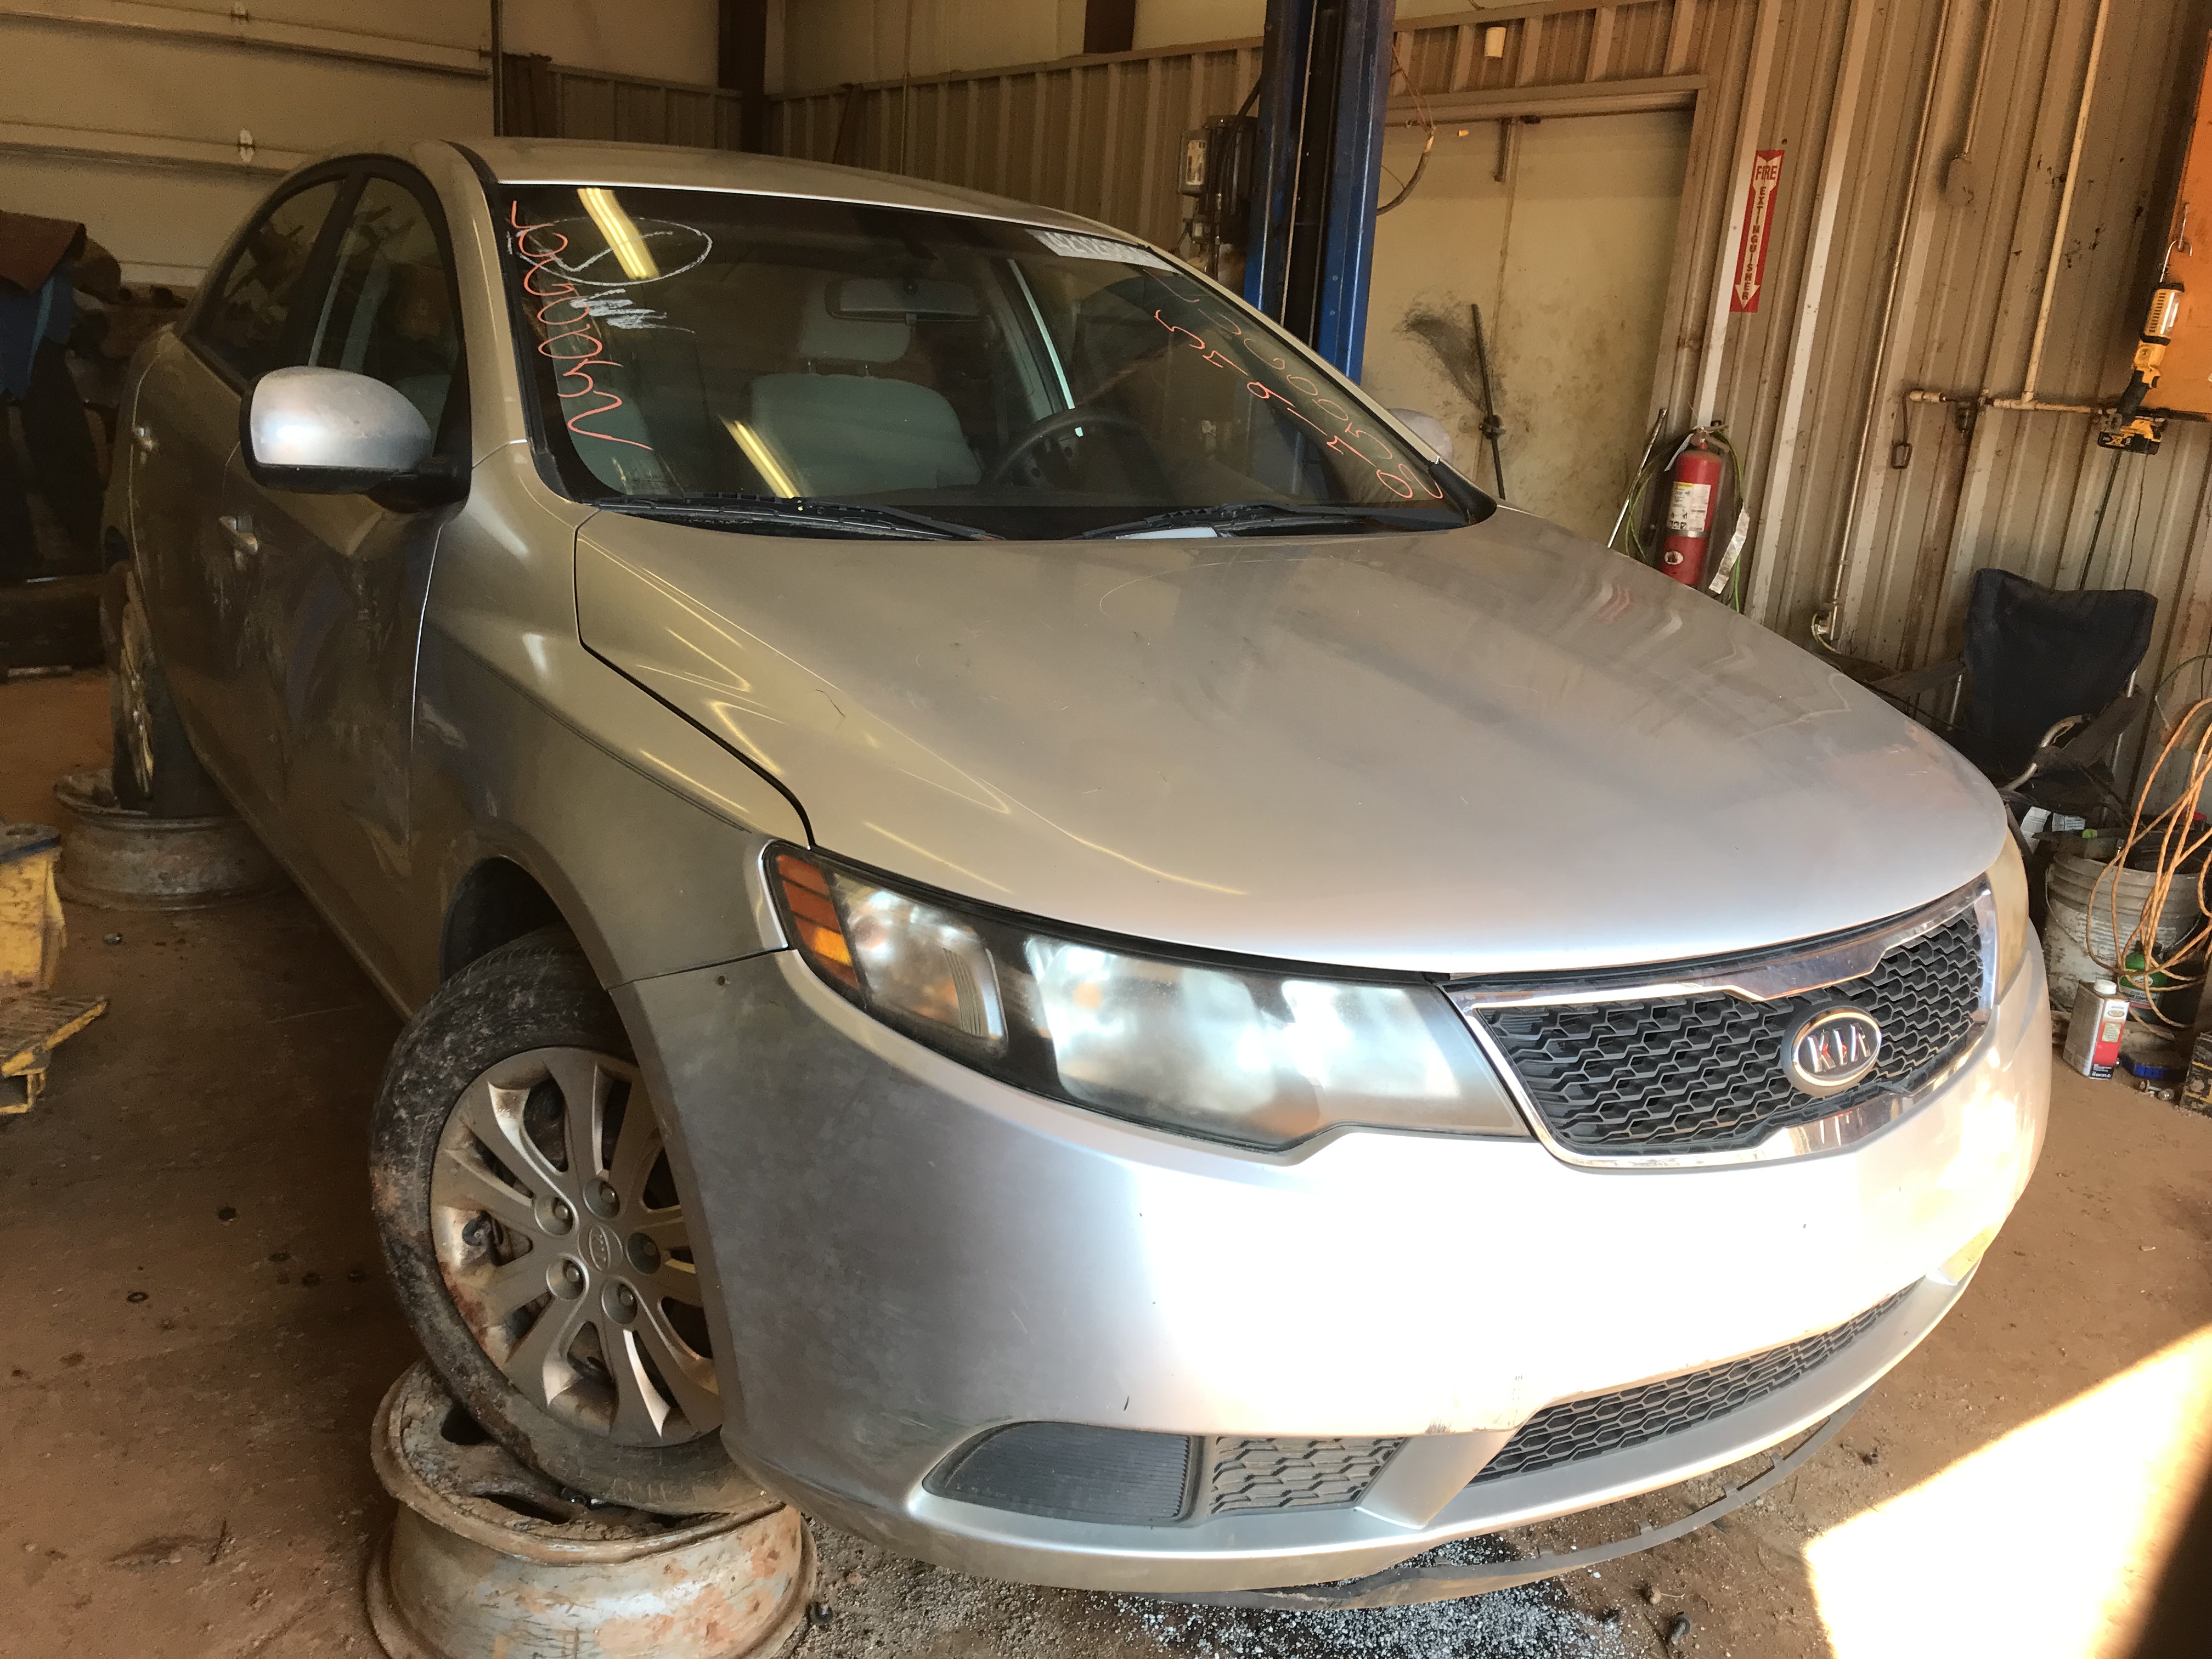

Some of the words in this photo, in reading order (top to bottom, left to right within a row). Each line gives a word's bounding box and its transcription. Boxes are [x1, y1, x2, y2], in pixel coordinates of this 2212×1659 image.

[1755, 165, 1778, 180] FIRE
[1741, 186, 1767, 301] EXTINGUISHER
[1807, 1022, 1871, 1073] KIA
